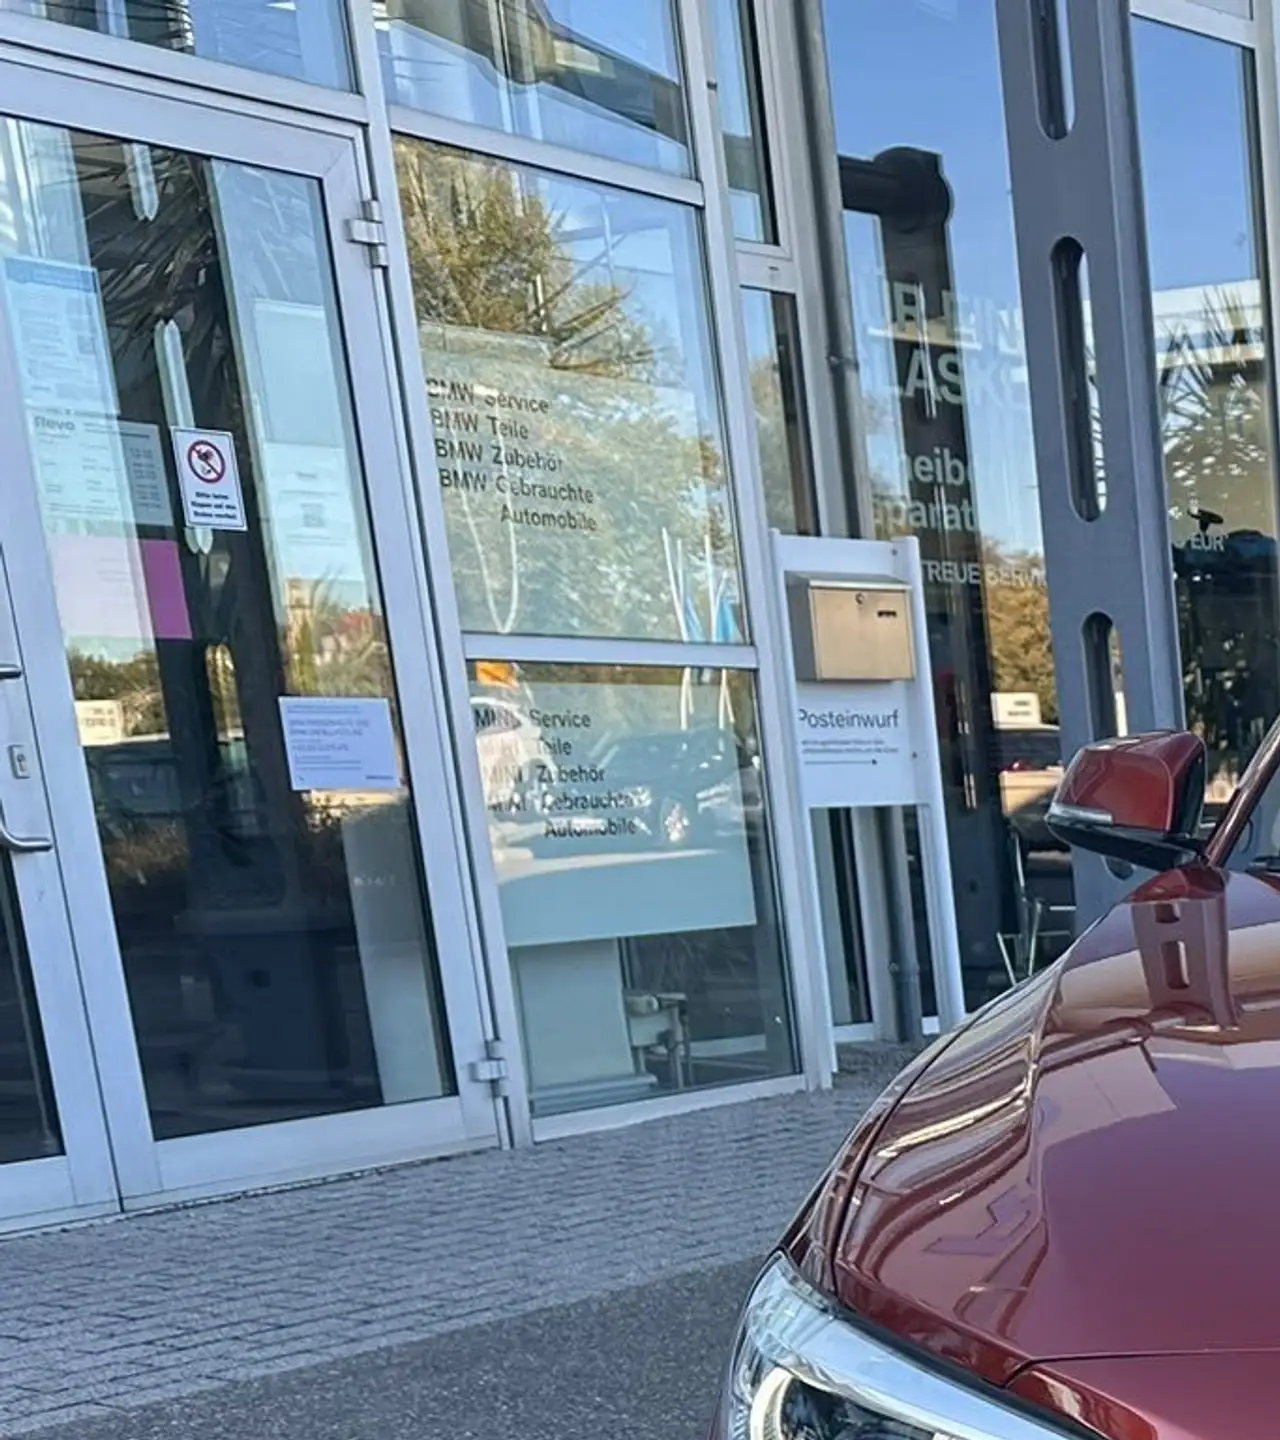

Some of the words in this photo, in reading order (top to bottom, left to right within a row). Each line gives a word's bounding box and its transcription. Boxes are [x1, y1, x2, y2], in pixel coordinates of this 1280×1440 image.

[431, 408, 479, 432] BMW
[486, 415, 529, 440] Teile
[434, 438, 483, 462] BMW
[491, 444, 564, 471] Zubehör
[439, 468, 488, 493] BMW
[496, 474, 595, 504] Gebrauchte
[501, 503, 598, 532] Automobile
[529, 709, 592, 729] Service
[798, 708, 899, 729] Posteinwurf
